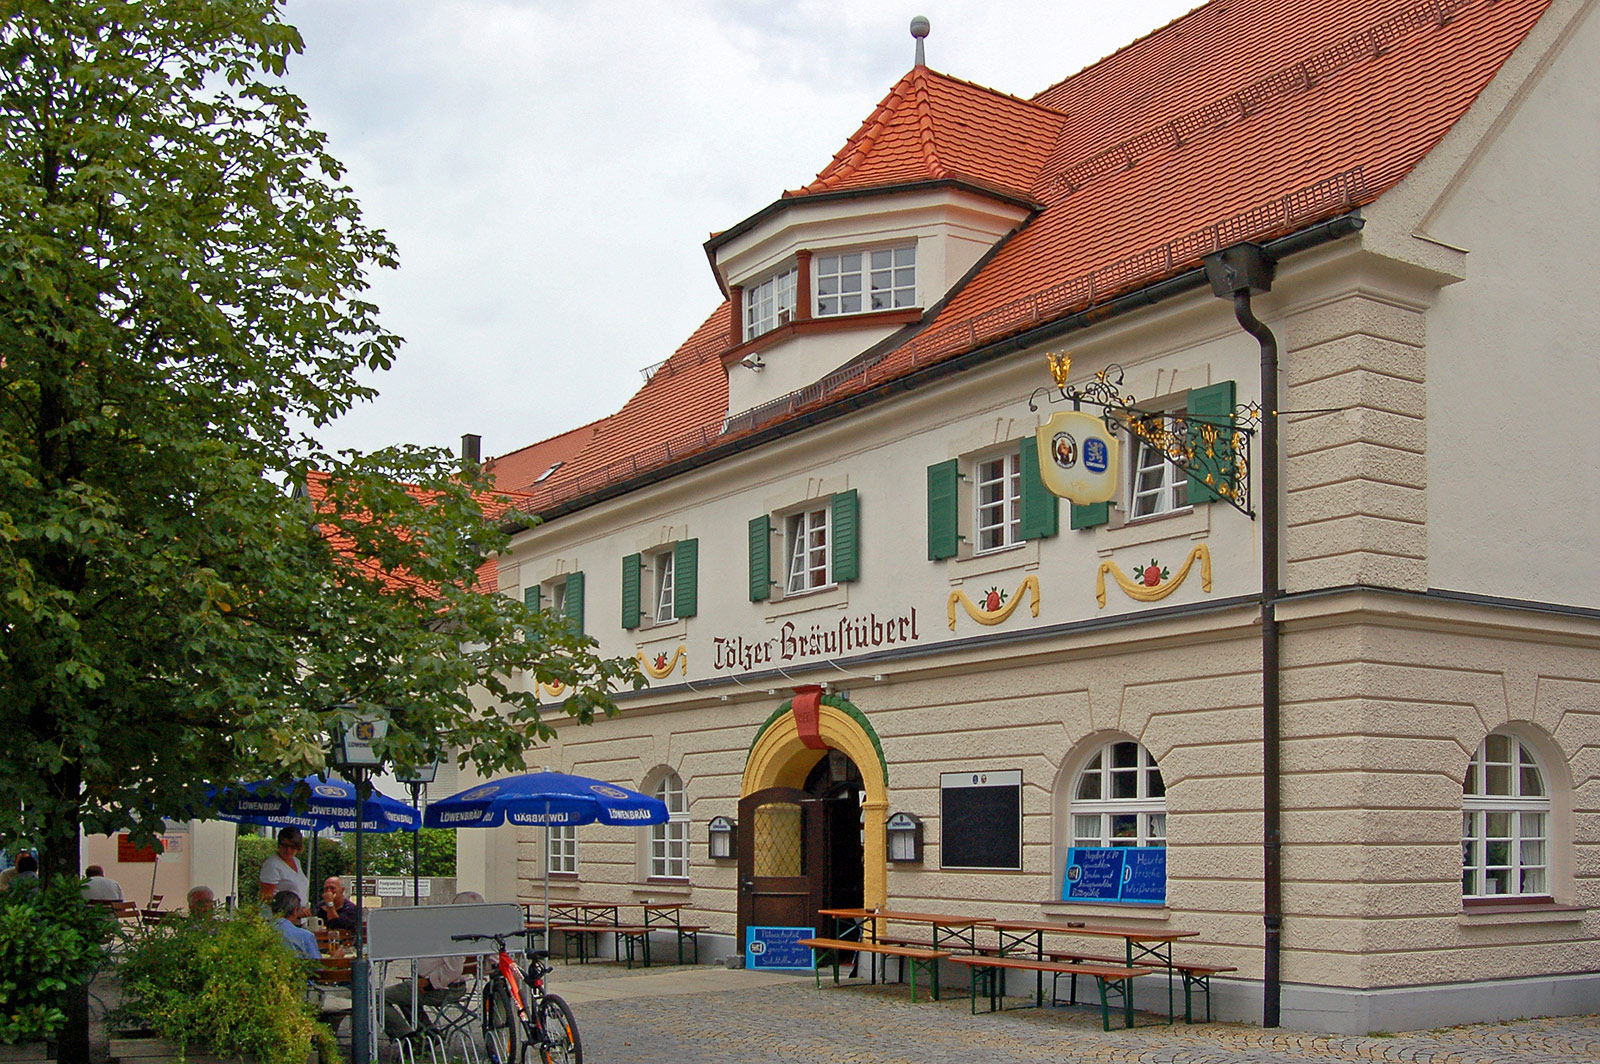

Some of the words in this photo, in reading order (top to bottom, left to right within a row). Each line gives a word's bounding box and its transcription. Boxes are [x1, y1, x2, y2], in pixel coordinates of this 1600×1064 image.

[713, 636, 771, 671] Tölzer
[238, 801, 282, 811] LÖWENBRÄU
[308, 804, 357, 817] ÖWENBRÄ
[440, 809, 482, 822] LÖWENBRÄU
[608, 808, 651, 820] LÖWENBRÄU
[1137, 852, 1164, 865] Heute
[1134, 865, 1161, 878] frische
